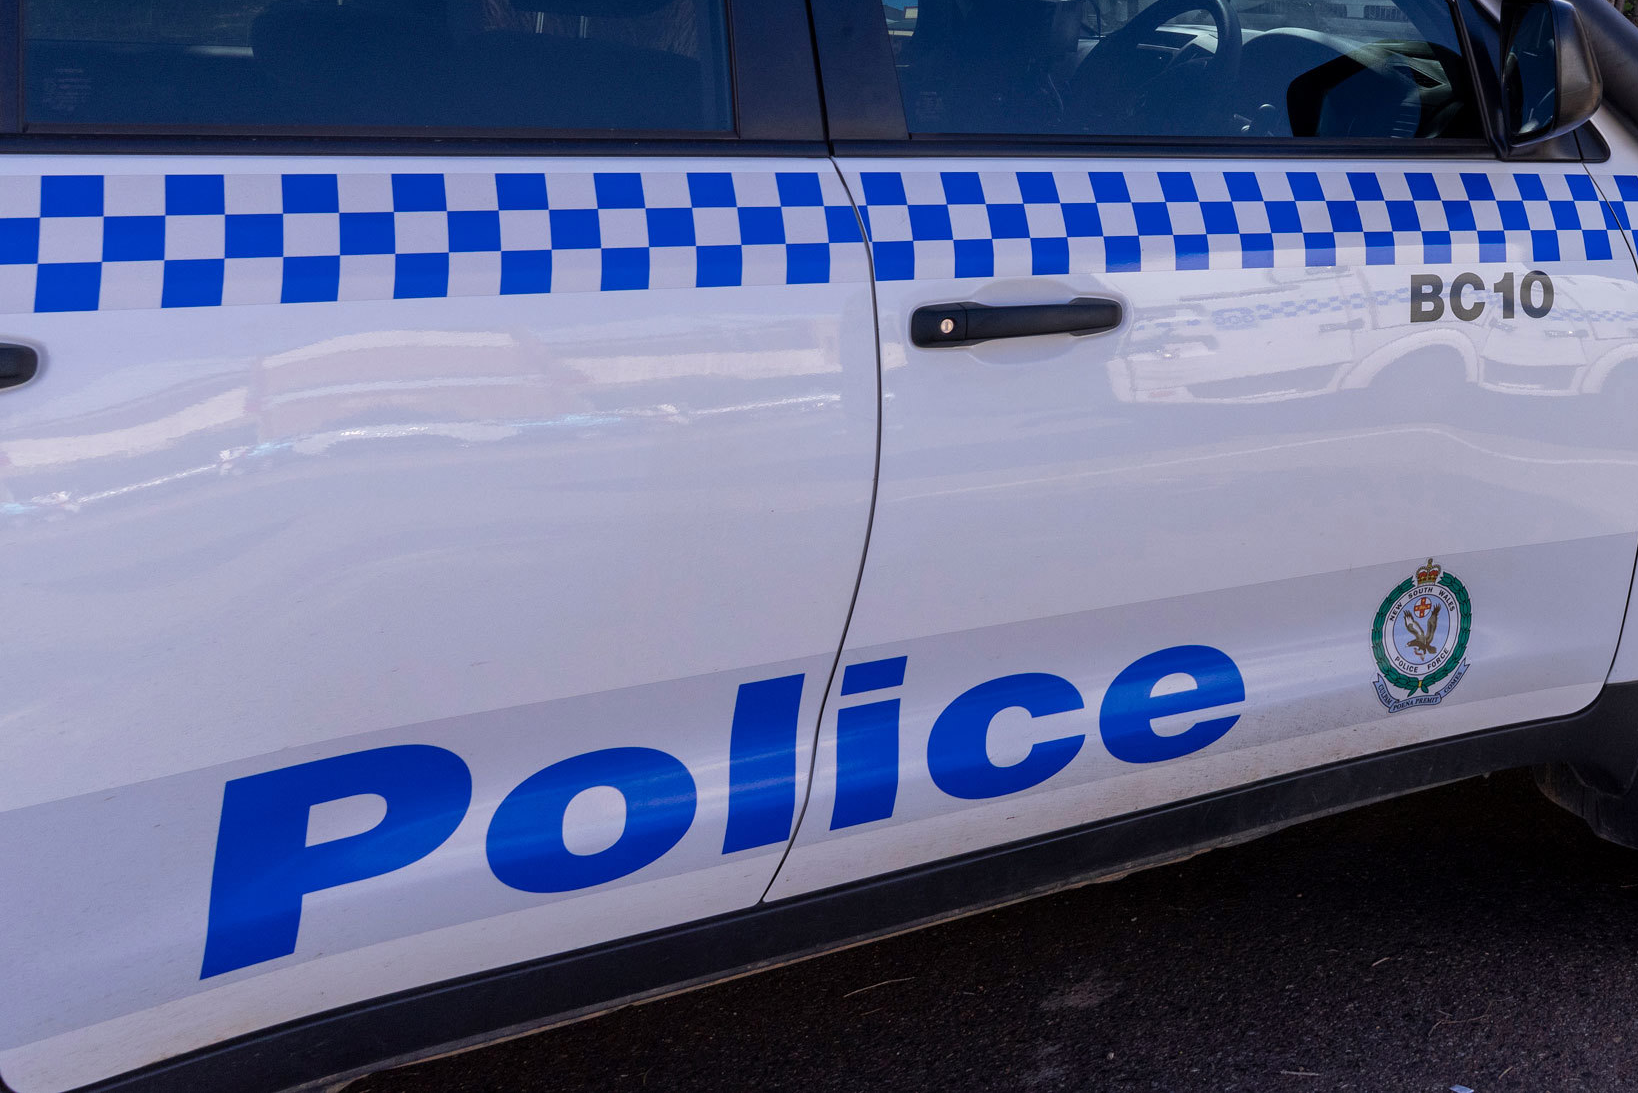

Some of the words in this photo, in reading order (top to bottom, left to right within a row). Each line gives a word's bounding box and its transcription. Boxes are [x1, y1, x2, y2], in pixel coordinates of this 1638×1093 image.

[1410, 270, 1554, 323] BC10
[1389, 602, 1403, 621] NEW
[1407, 587, 1434, 599] SOUTH
[1438, 589, 1455, 612] WALES
[1394, 656, 1418, 673] POLICE
[1427, 648, 1449, 670] FORCE
[1378, 684, 1393, 705] CULPAM
[1393, 701, 1414, 710] POENA
[1414, 697, 1439, 705] PREMIT
[1444, 671, 1462, 693] COMES
[200, 644, 1246, 980] Police
